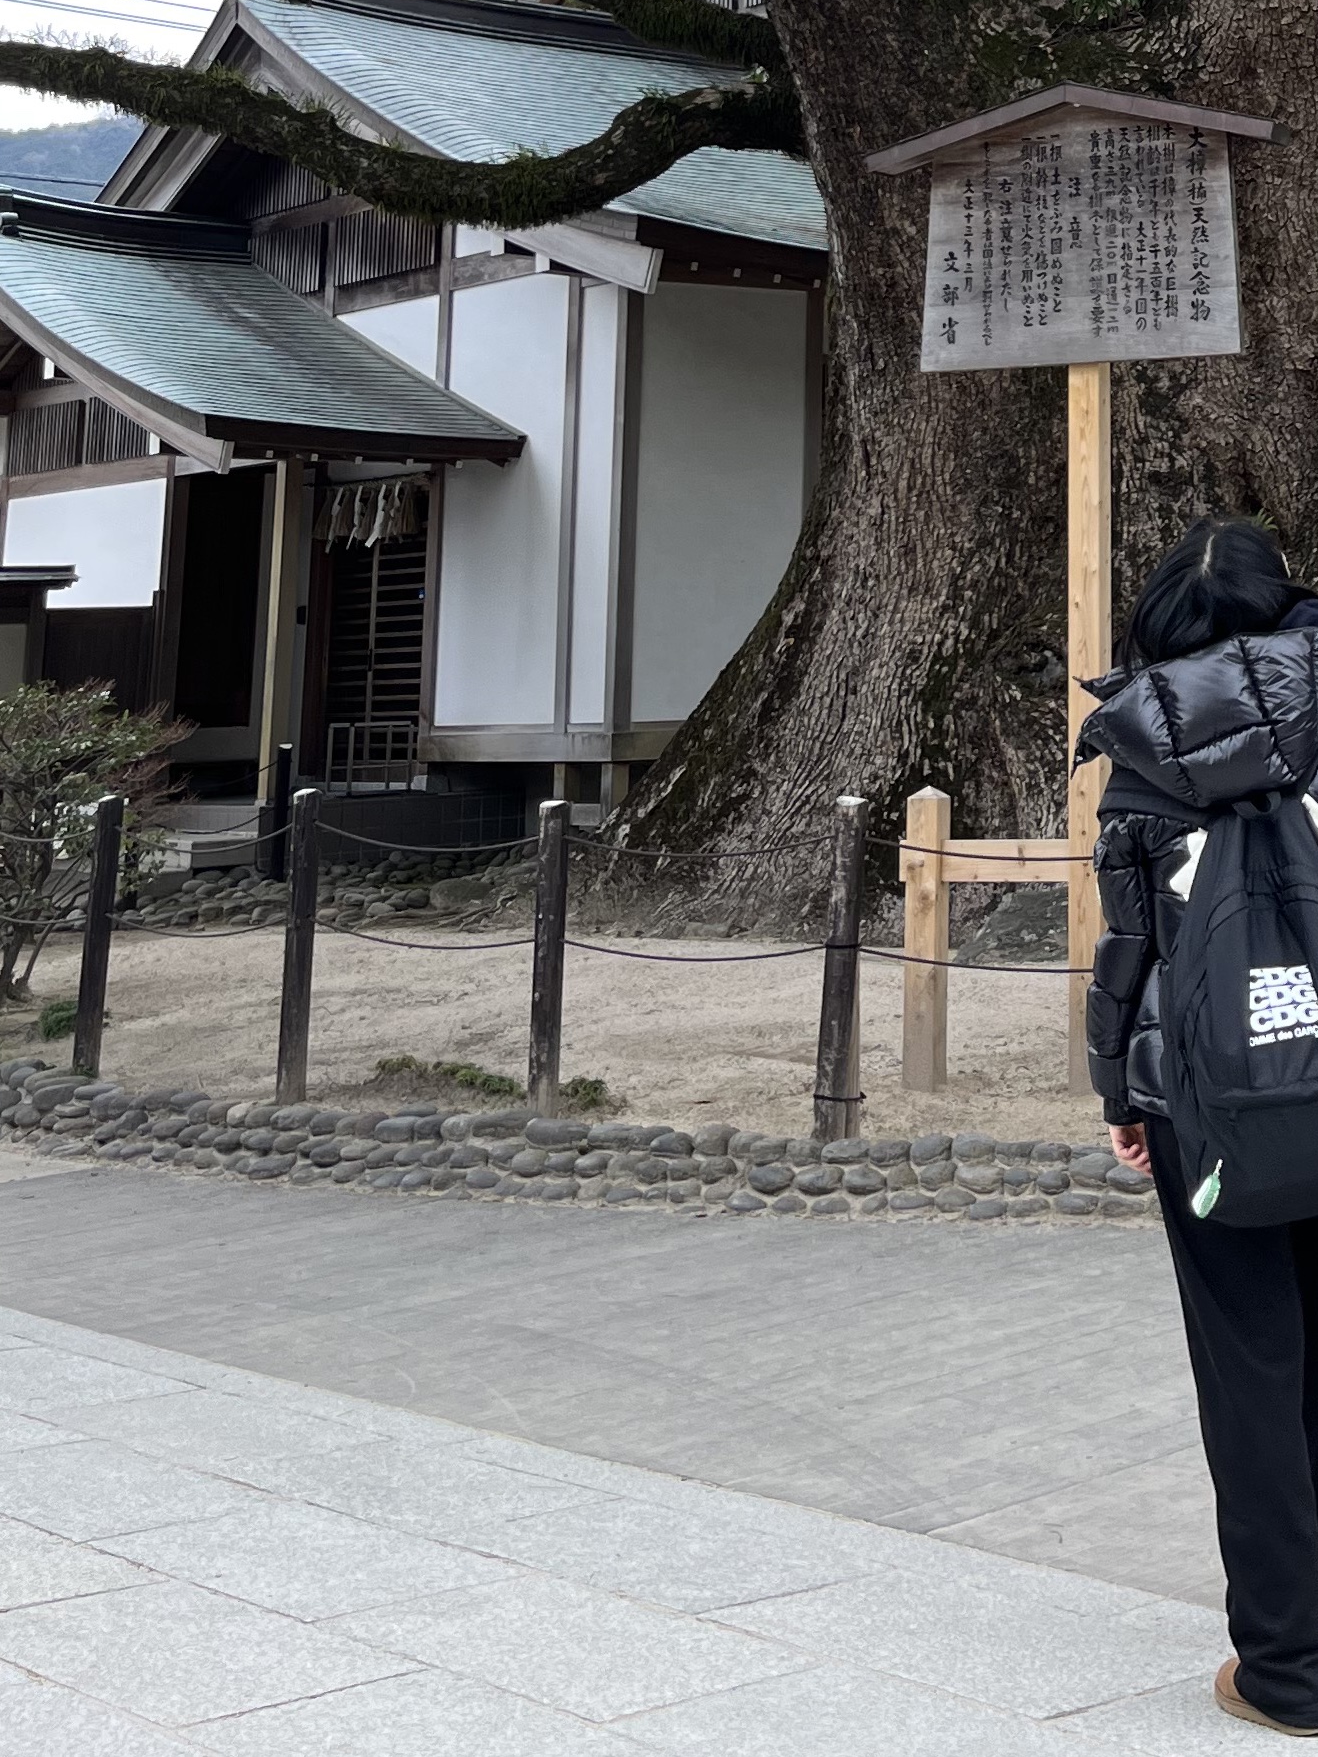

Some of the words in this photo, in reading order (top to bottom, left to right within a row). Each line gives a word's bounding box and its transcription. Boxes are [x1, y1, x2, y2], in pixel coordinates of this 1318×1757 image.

[962, 178, 975, 293] 大正十三年三月
[1067, 176, 1082, 249] 注意
[939, 250, 960, 345] 文部省
[1249, 964, 1313, 990] CDG
[1249, 985, 1318, 1011] CDG
[1249, 1033, 1276, 1047] OMME
[1277, 1029, 1293, 1041] des
